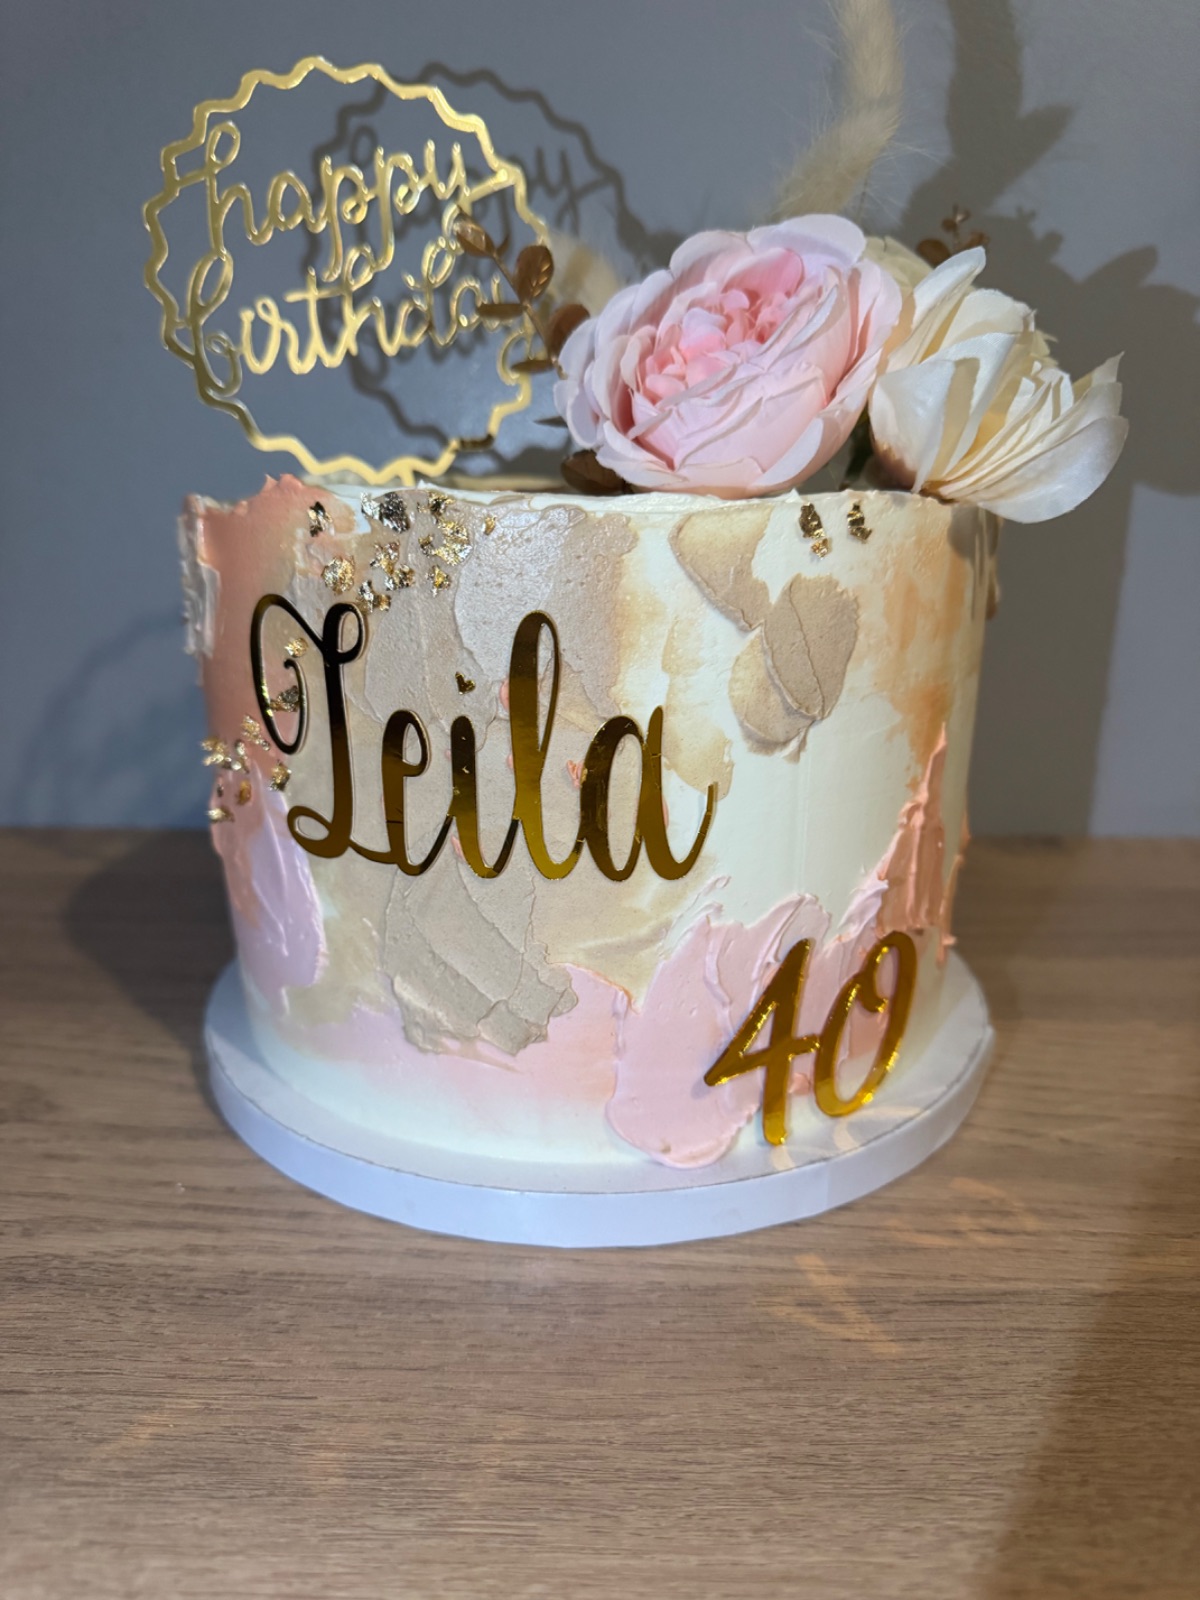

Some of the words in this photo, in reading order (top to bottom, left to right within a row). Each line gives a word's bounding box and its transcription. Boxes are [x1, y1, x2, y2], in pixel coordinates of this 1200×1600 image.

[204, 120, 472, 281] happy
[250, 594, 718, 881] Leila
[704, 931, 917, 1146] 40
